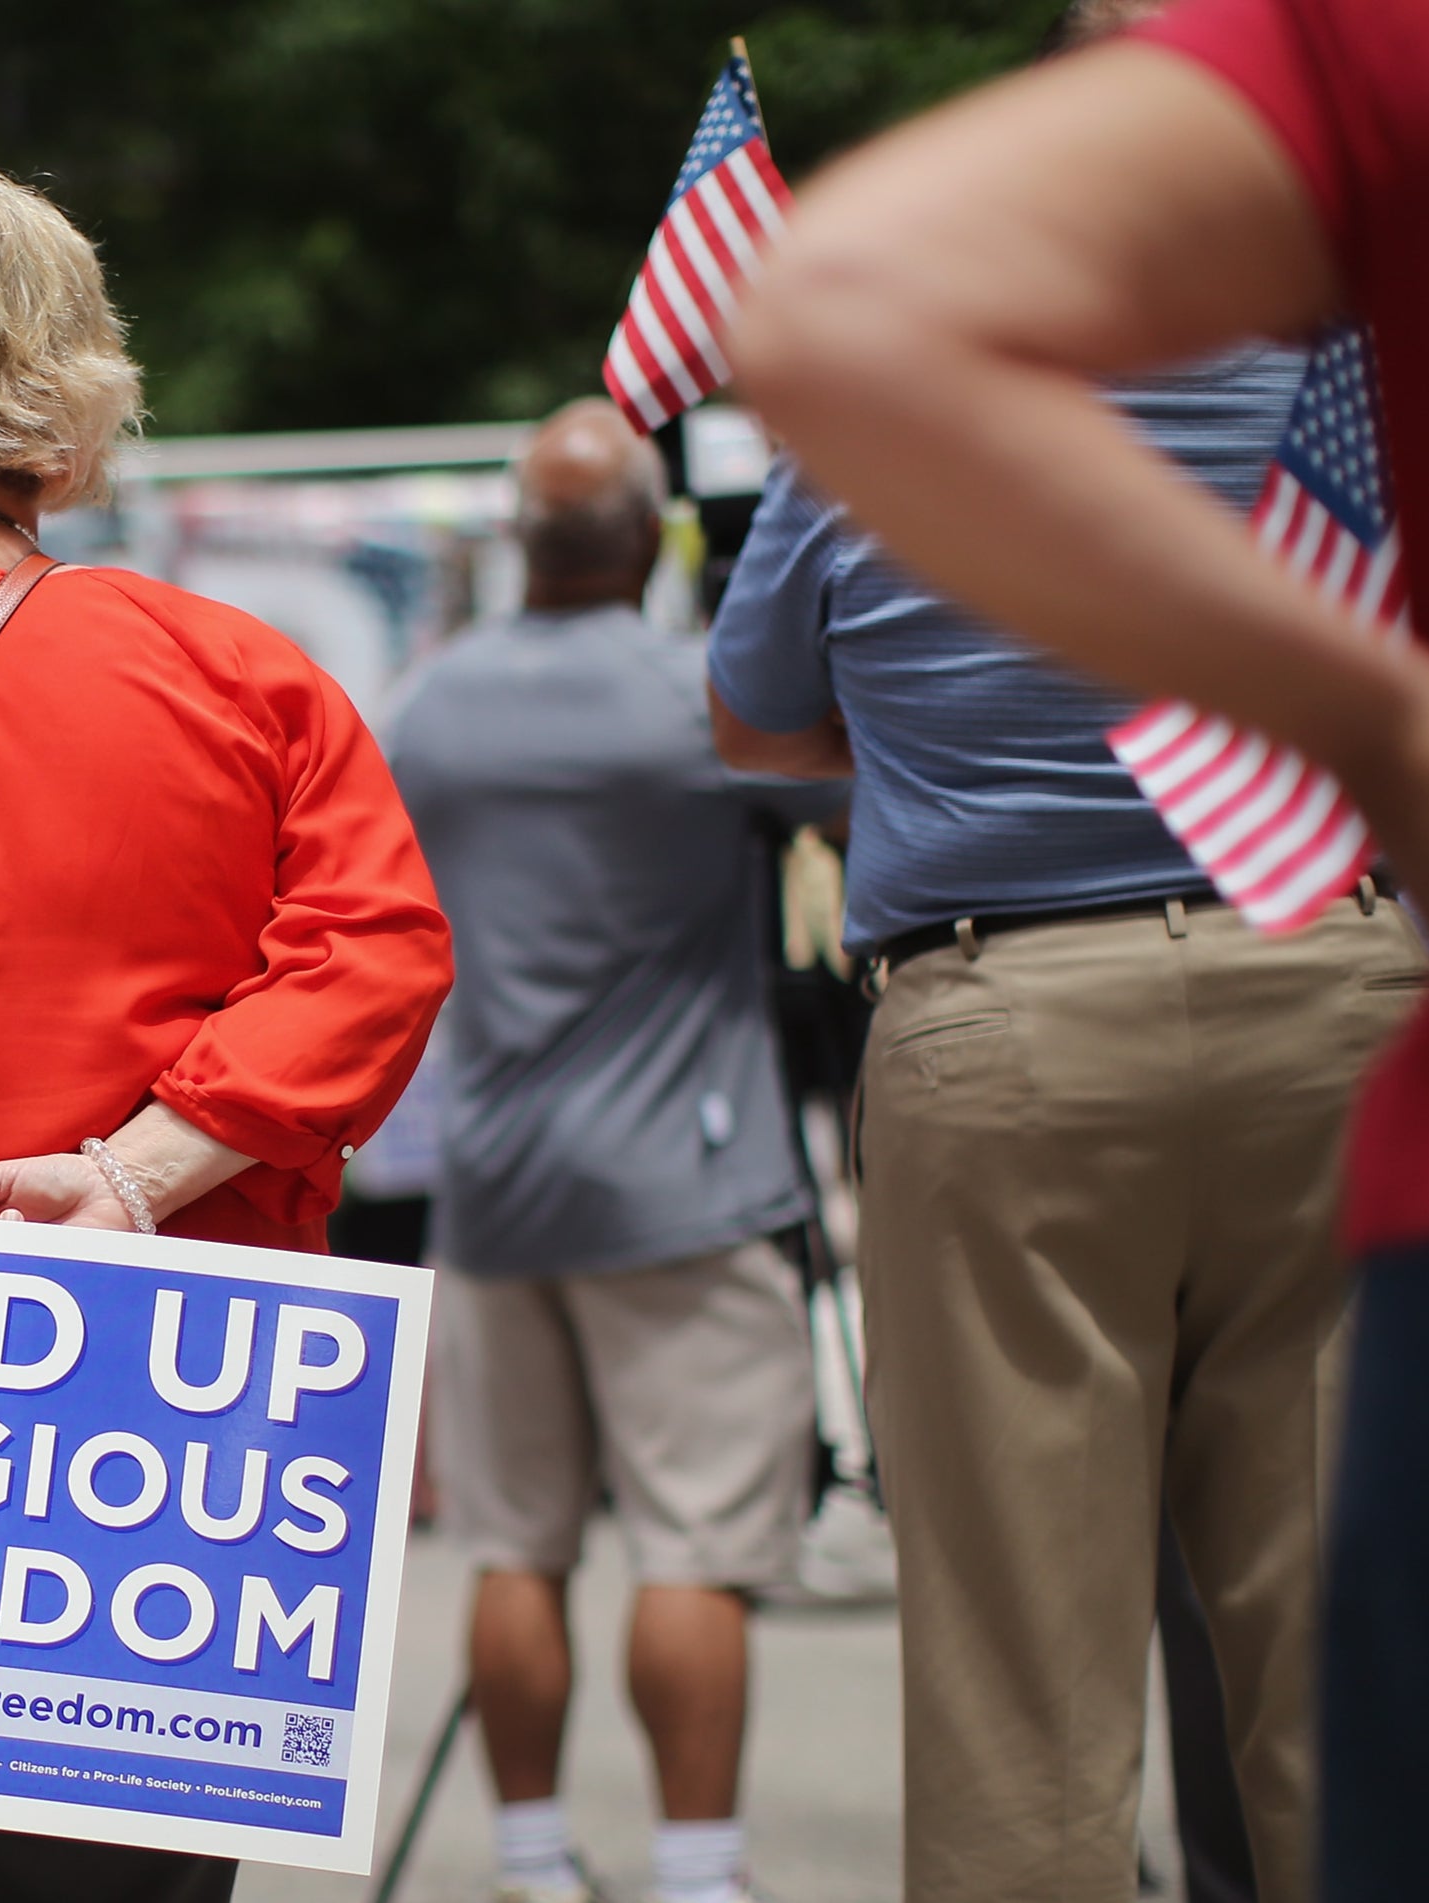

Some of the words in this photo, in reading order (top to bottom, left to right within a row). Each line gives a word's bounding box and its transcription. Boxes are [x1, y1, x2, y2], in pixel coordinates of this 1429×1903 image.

[150, 1290, 365, 1421] UP
[9, 1760, 58, 1776] Citizens
[61, 1766, 80, 1780] for
[82, 1771, 91, 1781] a
[93, 1770, 143, 1787] Pro-Life
[145, 1777, 192, 1794] Society
[204, 1784, 322, 1810] ProLifeSociety.com
